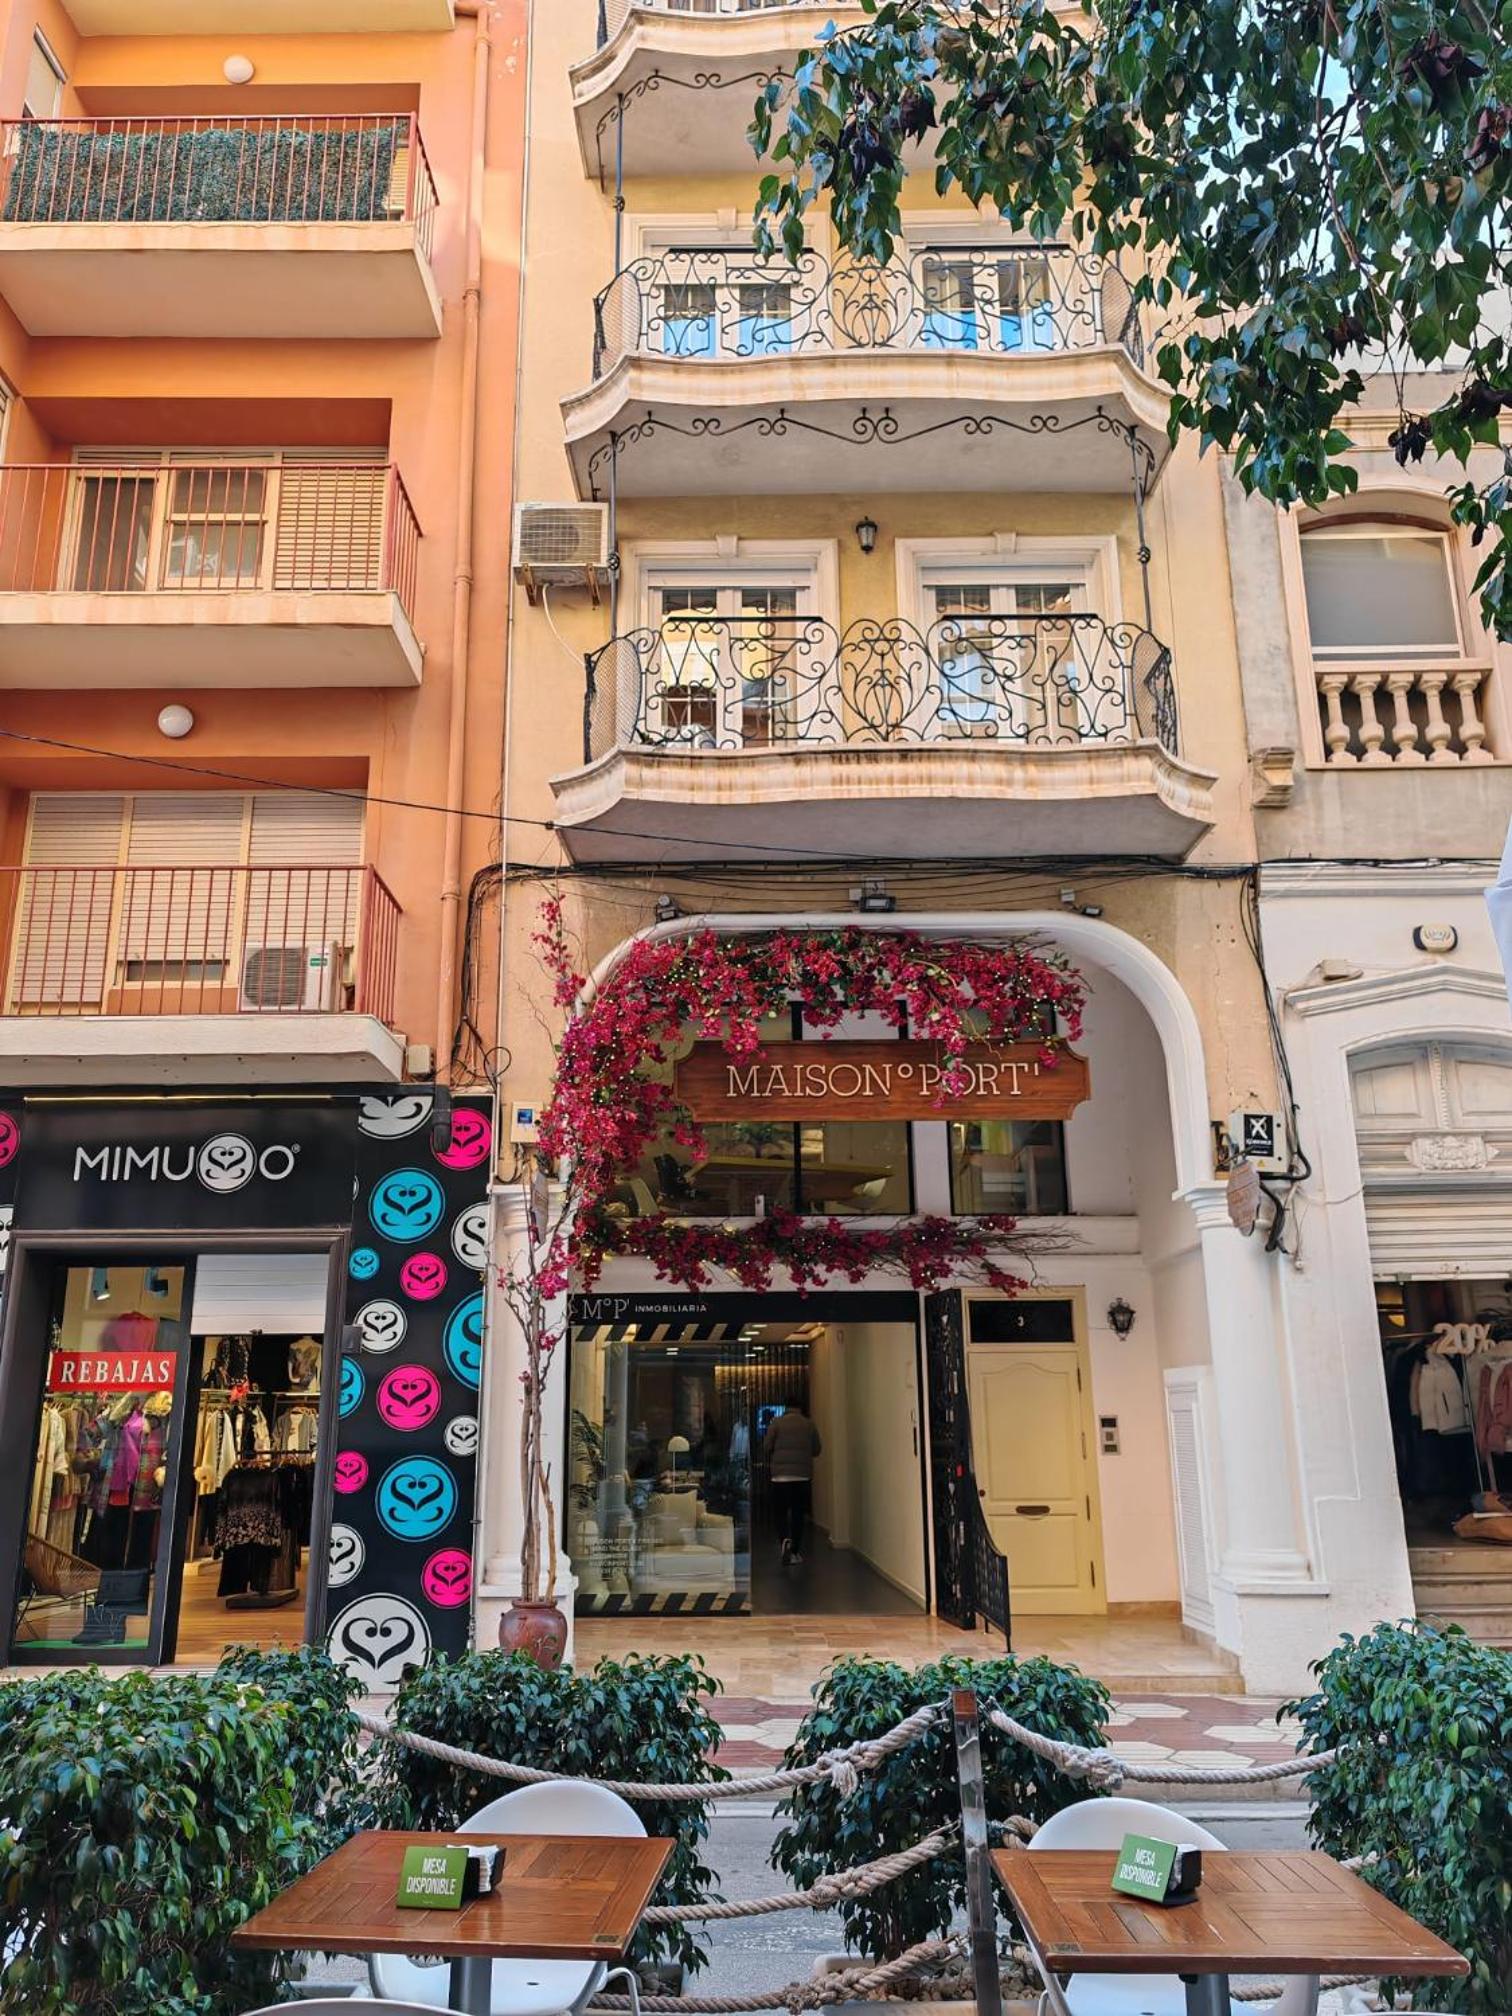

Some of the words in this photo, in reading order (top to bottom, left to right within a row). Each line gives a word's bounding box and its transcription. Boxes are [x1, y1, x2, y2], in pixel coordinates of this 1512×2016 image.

[634, 1304, 707, 1313] INMOBILIARIA
[1431, 1322, 1496, 1354] 20%
[61, 1360, 170, 1383] REBAJAS
[422, 1857, 448, 1875] MESA
[1135, 1847, 1156, 1868] MESA
[405, 1875, 457, 1895] DISPONIBLE
[1118, 1862, 1164, 1888] DISPONIBLE
